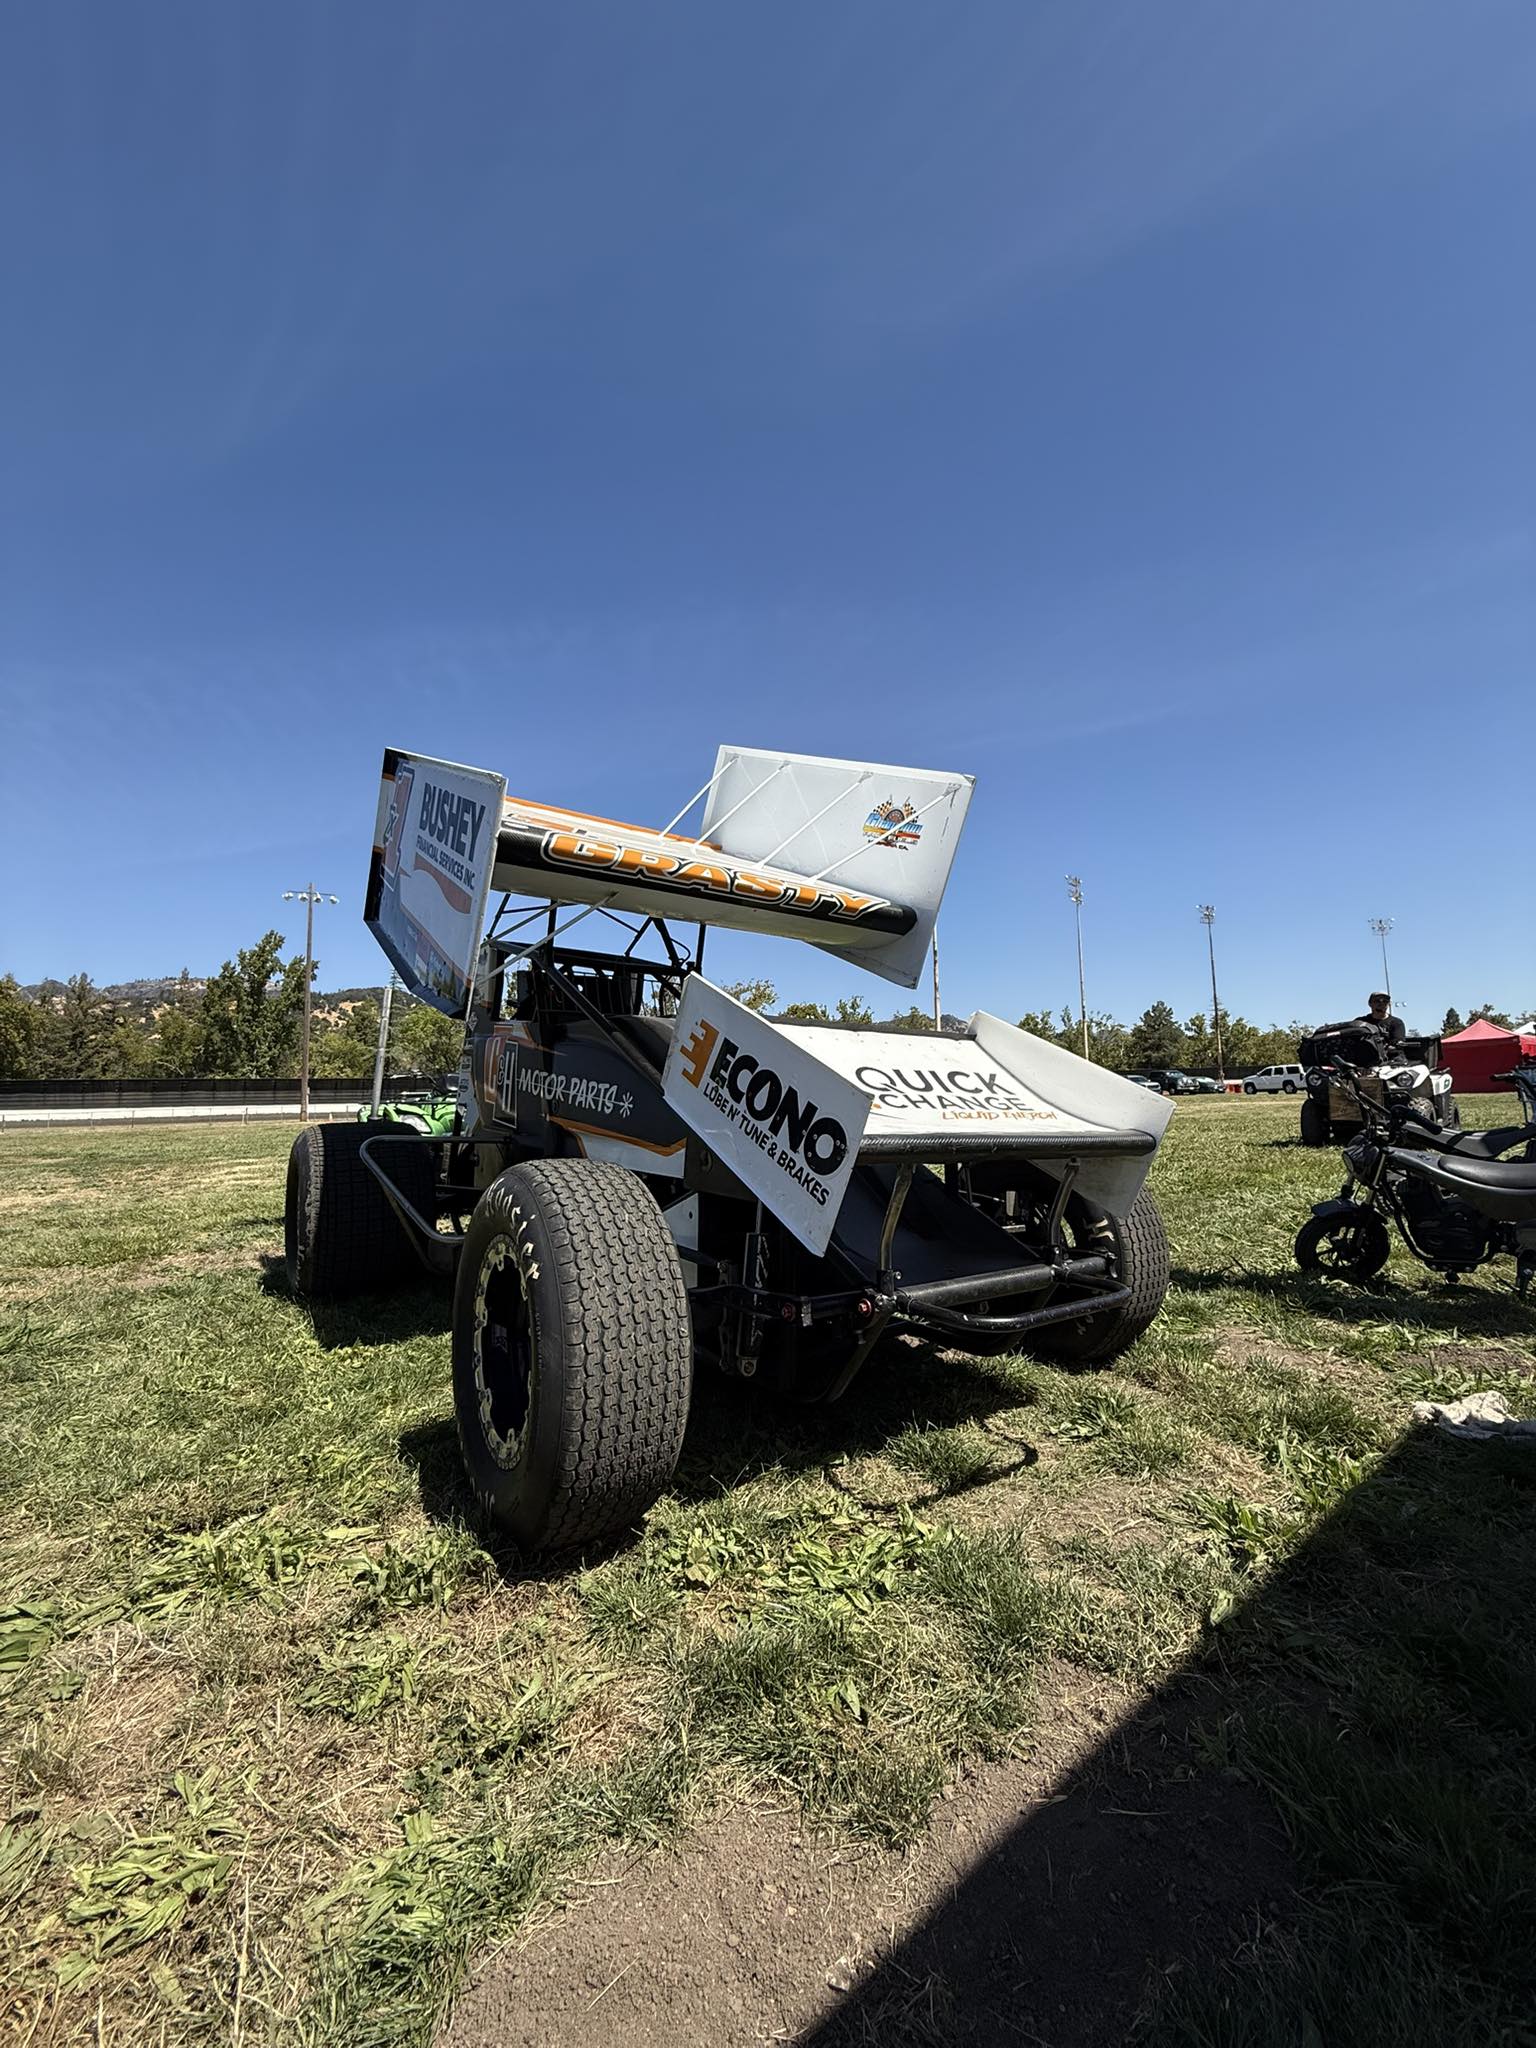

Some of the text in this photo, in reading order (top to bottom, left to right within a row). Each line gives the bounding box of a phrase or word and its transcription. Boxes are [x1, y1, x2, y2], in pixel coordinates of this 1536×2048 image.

[419, 782, 486, 862] BUSHEY
[416, 835, 439, 863] FINANCIAL
[439, 848, 464, 882] SERVICES
[544, 832, 888, 918] GRASTY
[518, 1067, 618, 1114] MOTOR PARTS
[709, 1037, 848, 1176] ECONO
[855, 1066, 1016, 1095] QUICK
[703, 1081, 728, 1114] LUBE
[740, 1114, 770, 1151] TUNE
[767, 1143, 778, 1160] &
[776, 1150, 830, 1206] BRAKES
[942, 1111, 999, 1121] LIQUID
